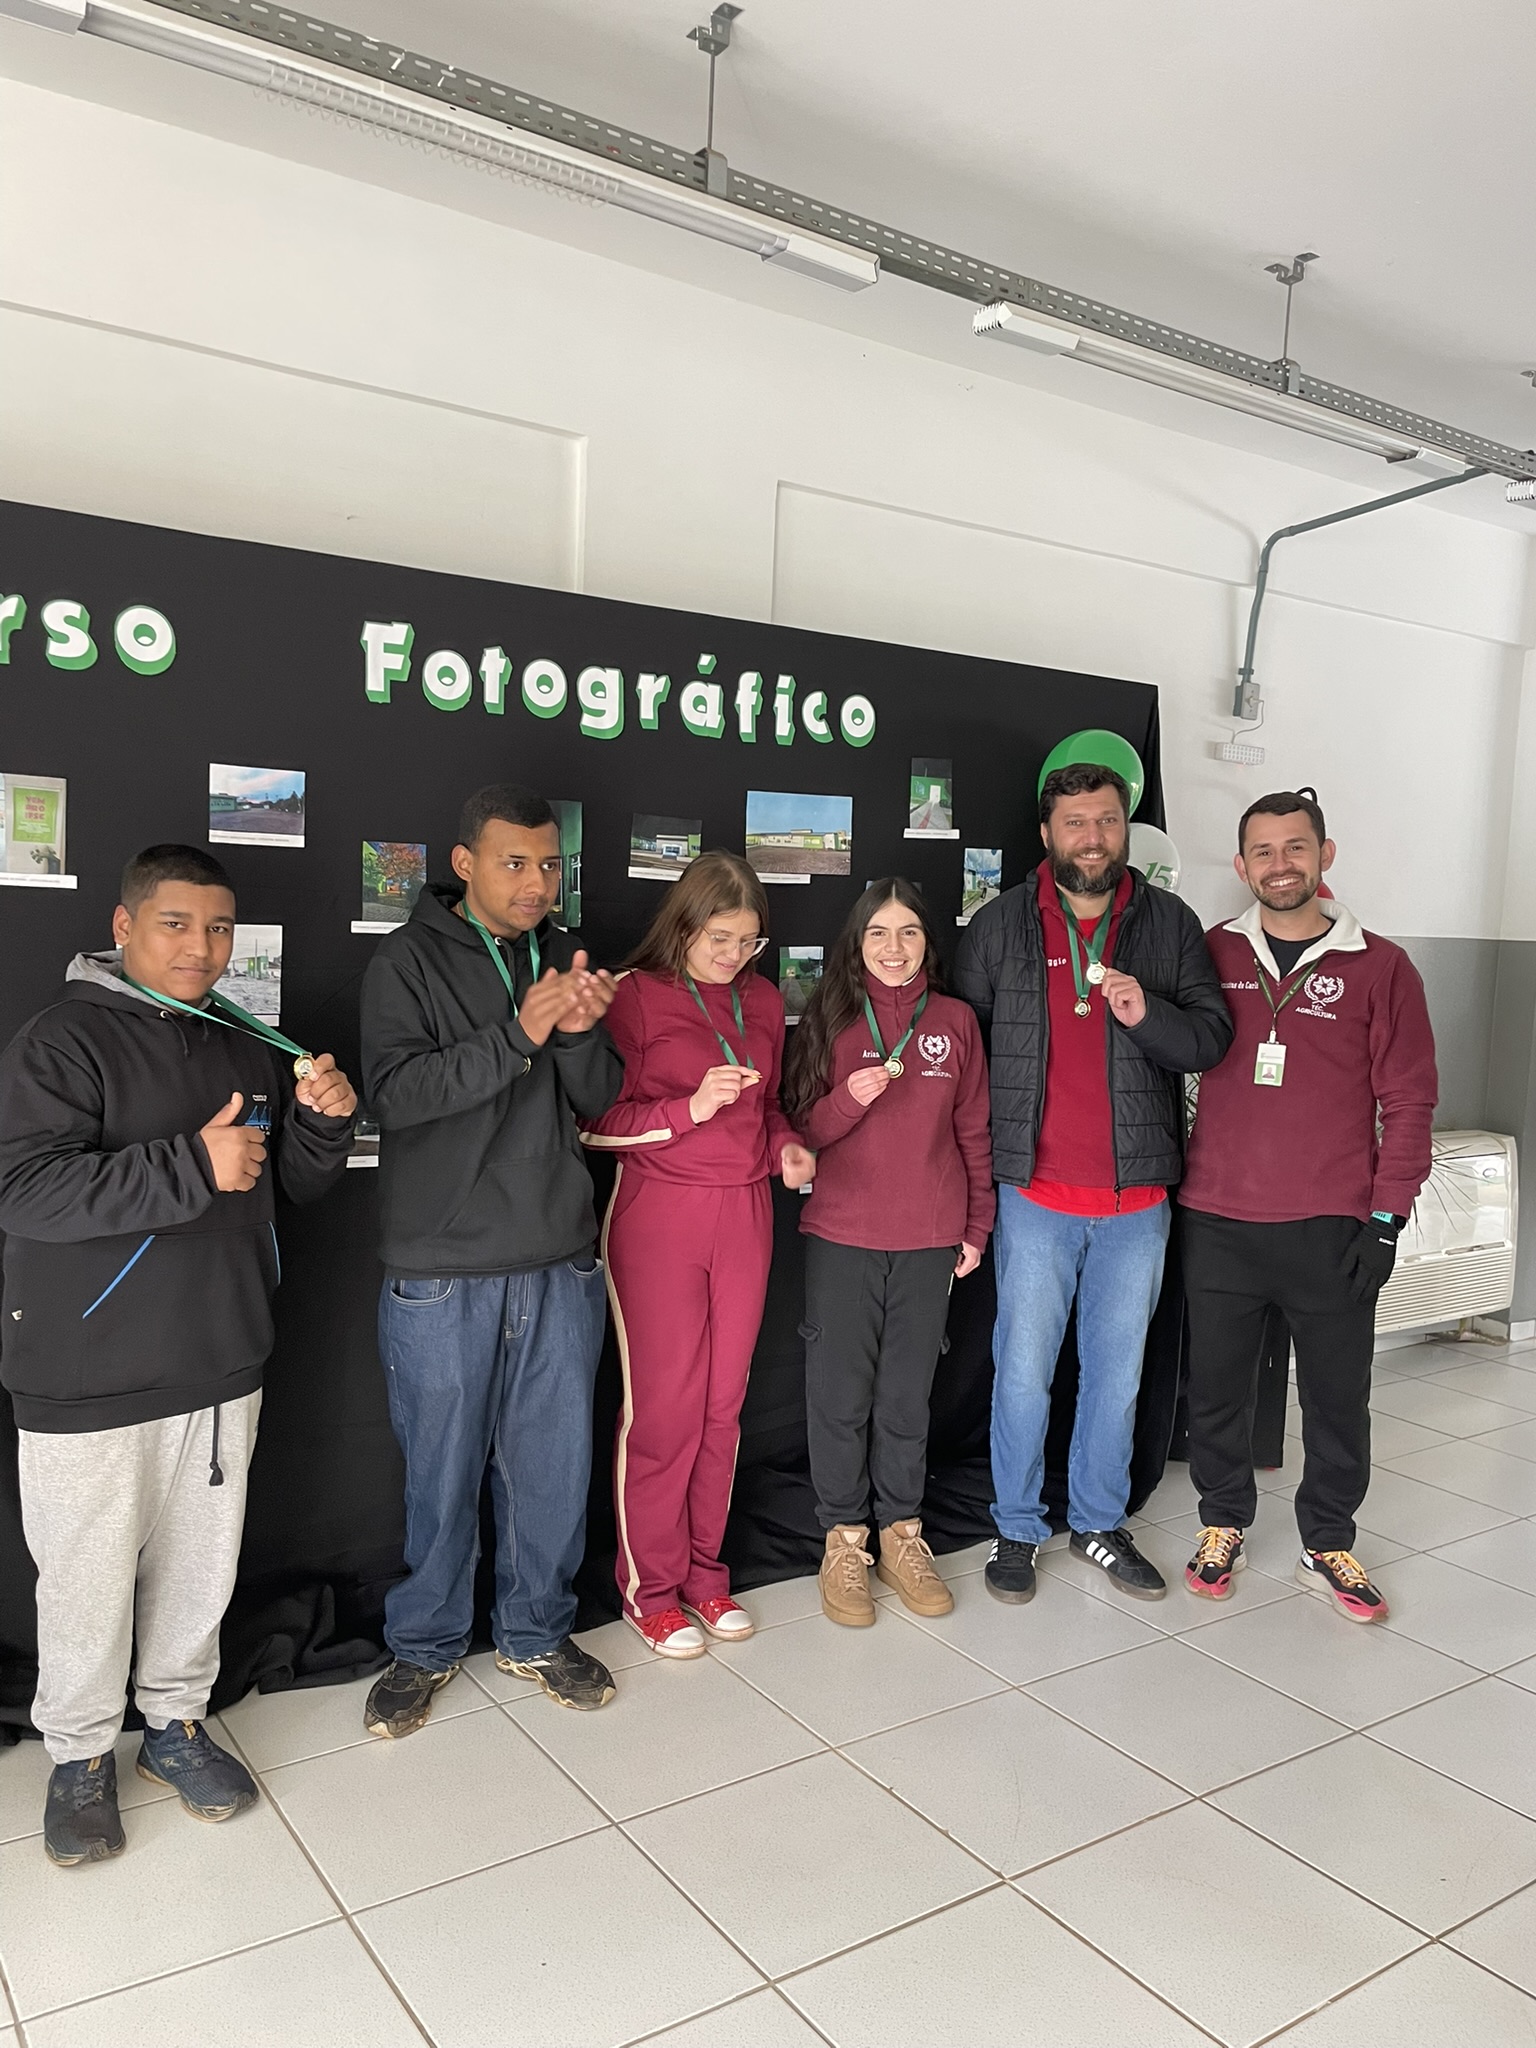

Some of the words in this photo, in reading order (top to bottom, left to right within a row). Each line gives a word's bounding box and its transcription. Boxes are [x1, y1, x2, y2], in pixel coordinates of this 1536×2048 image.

[360, 620, 877, 747] Fotográfico
[1146, 861, 1174, 889] 15
[1295, 1006, 1337, 1020] AGRICULTURA
